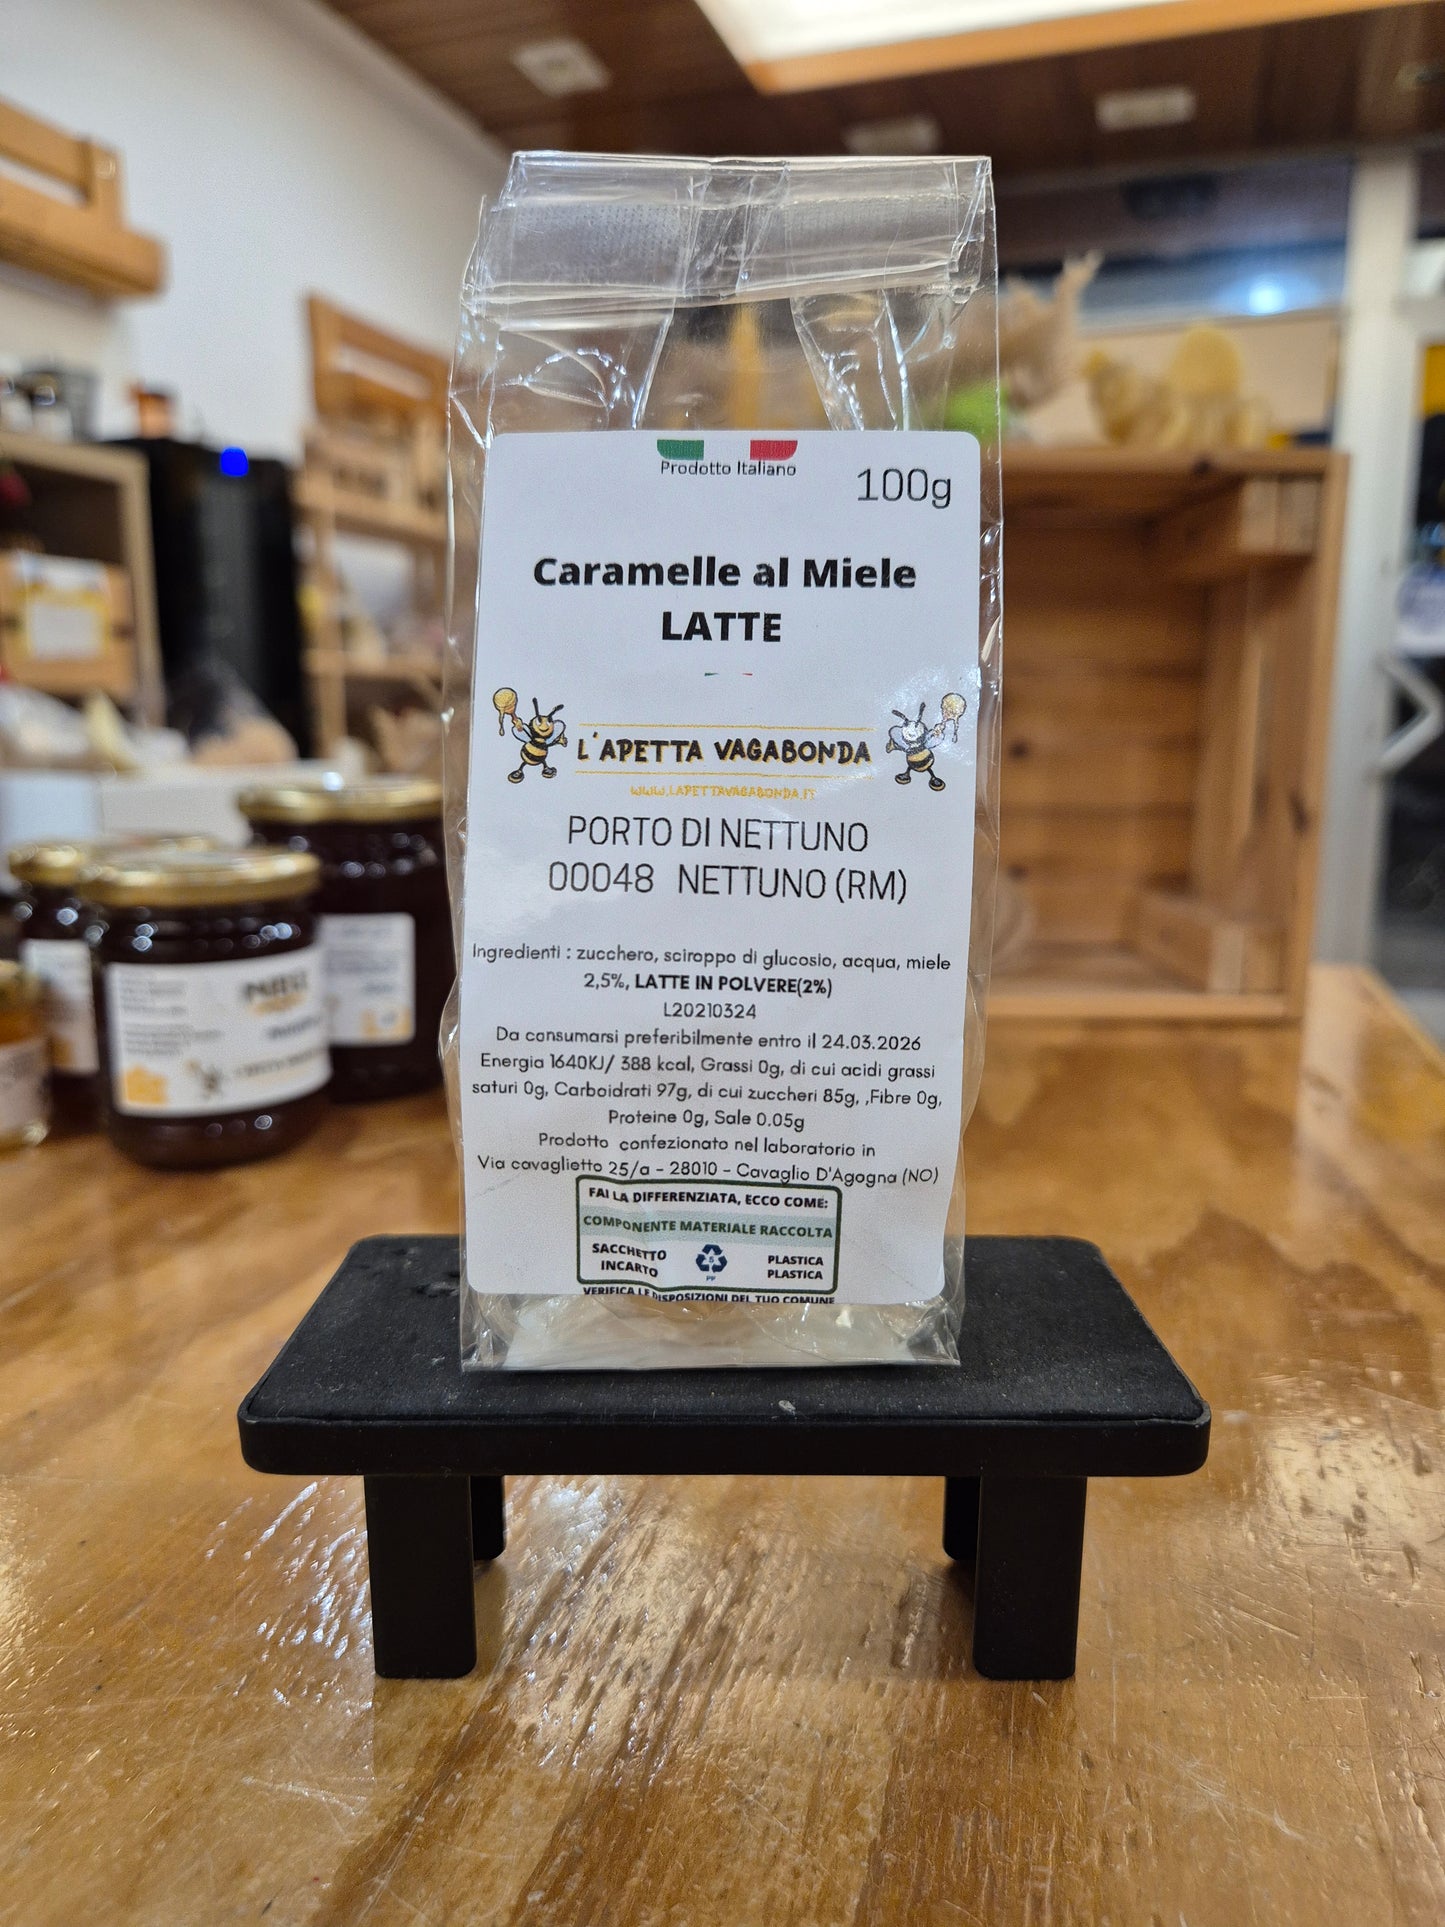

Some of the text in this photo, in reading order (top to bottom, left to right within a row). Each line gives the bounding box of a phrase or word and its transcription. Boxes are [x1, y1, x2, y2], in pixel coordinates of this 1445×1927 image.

[660, 460, 797, 477] Prodotto Italiano
[857, 467, 953, 510] 100g
[533, 557, 918, 589] Caramelle al Miele
[662, 611, 782, 643] LATTE
[577, 732, 872, 765] L'APETTA VAGABONDA
[568, 815, 869, 852] PORTO DI NETTUNO
[549, 861, 907, 904] 00048 NETTUNO (RM)
[472, 943, 561, 963] Ingredienti
[576, 944, 659, 963] zucchero,
[663, 949, 737, 967] sciroppo
[742, 948, 757, 964] di
[762, 949, 837, 970] glucosio,
[842, 956, 901, 973] acqua,
[906, 953, 951, 970] miele
[583, 972, 832, 998] 2,5%, LATTE IN POLVERE(2%)
[663, 1002, 757, 1019] L20210324
[496, 1026, 921, 1051] Da consumarsi preferibilmente entro il 24.03.2026
[481, 1053, 935, 1082] Energia 1640KJ/ 388 kcal, Grassi 0g, di cui acidi grassi
[472, 1080, 518, 1094] saturi
[523, 1080, 549, 1100] 0g,
[554, 1081, 652, 1098] Carboidrati
[657, 1083, 692, 1101] 97g,
[697, 1082, 713, 1098] di
[718, 1085, 743, 1099] cui
[749, 1086, 817, 1102] zuccheri
[823, 1088, 859, 1108] 85g,
[916, 1090, 942, 1109] 0g,
[608, 1109, 805, 1132] Proteine 0g, Sale 0.05g
[538, 1132, 876, 1157] Prodotto confezionato nel laboratorio in
[477, 1155, 505, 1169] Via
[511, 1156, 602, 1174] cavaglietto
[608, 1160, 650, 1179] 25/a
[669, 1161, 717, 1176] 28010
[736, 1162, 810, 1185] Cavaglio
[816, 1166, 898, 1187] D'Agogna
[902, 1167, 939, 1185] (NO)
[588, 1187, 828, 1209] FAI LA DIFFERENZIATA, ECCO COME:
[583, 1215, 833, 1238] COMPONENTE MATERIALE RACCOLTA
[592, 1243, 667, 1261] SACCHETTO
[767, 1255, 824, 1266] PLASTICA
[600, 1260, 658, 1278] INCARTO
[767, 1269, 823, 1280] PLASTICA
[583, 1286, 635, 1296] VERIFICA
[652, 1291, 728, 1302] DISPOSIZIONI
[731, 1294, 750, 1303] DEL
[755, 1295, 780, 1304] TUO
[782, 1296, 836, 1305] COMUNE
